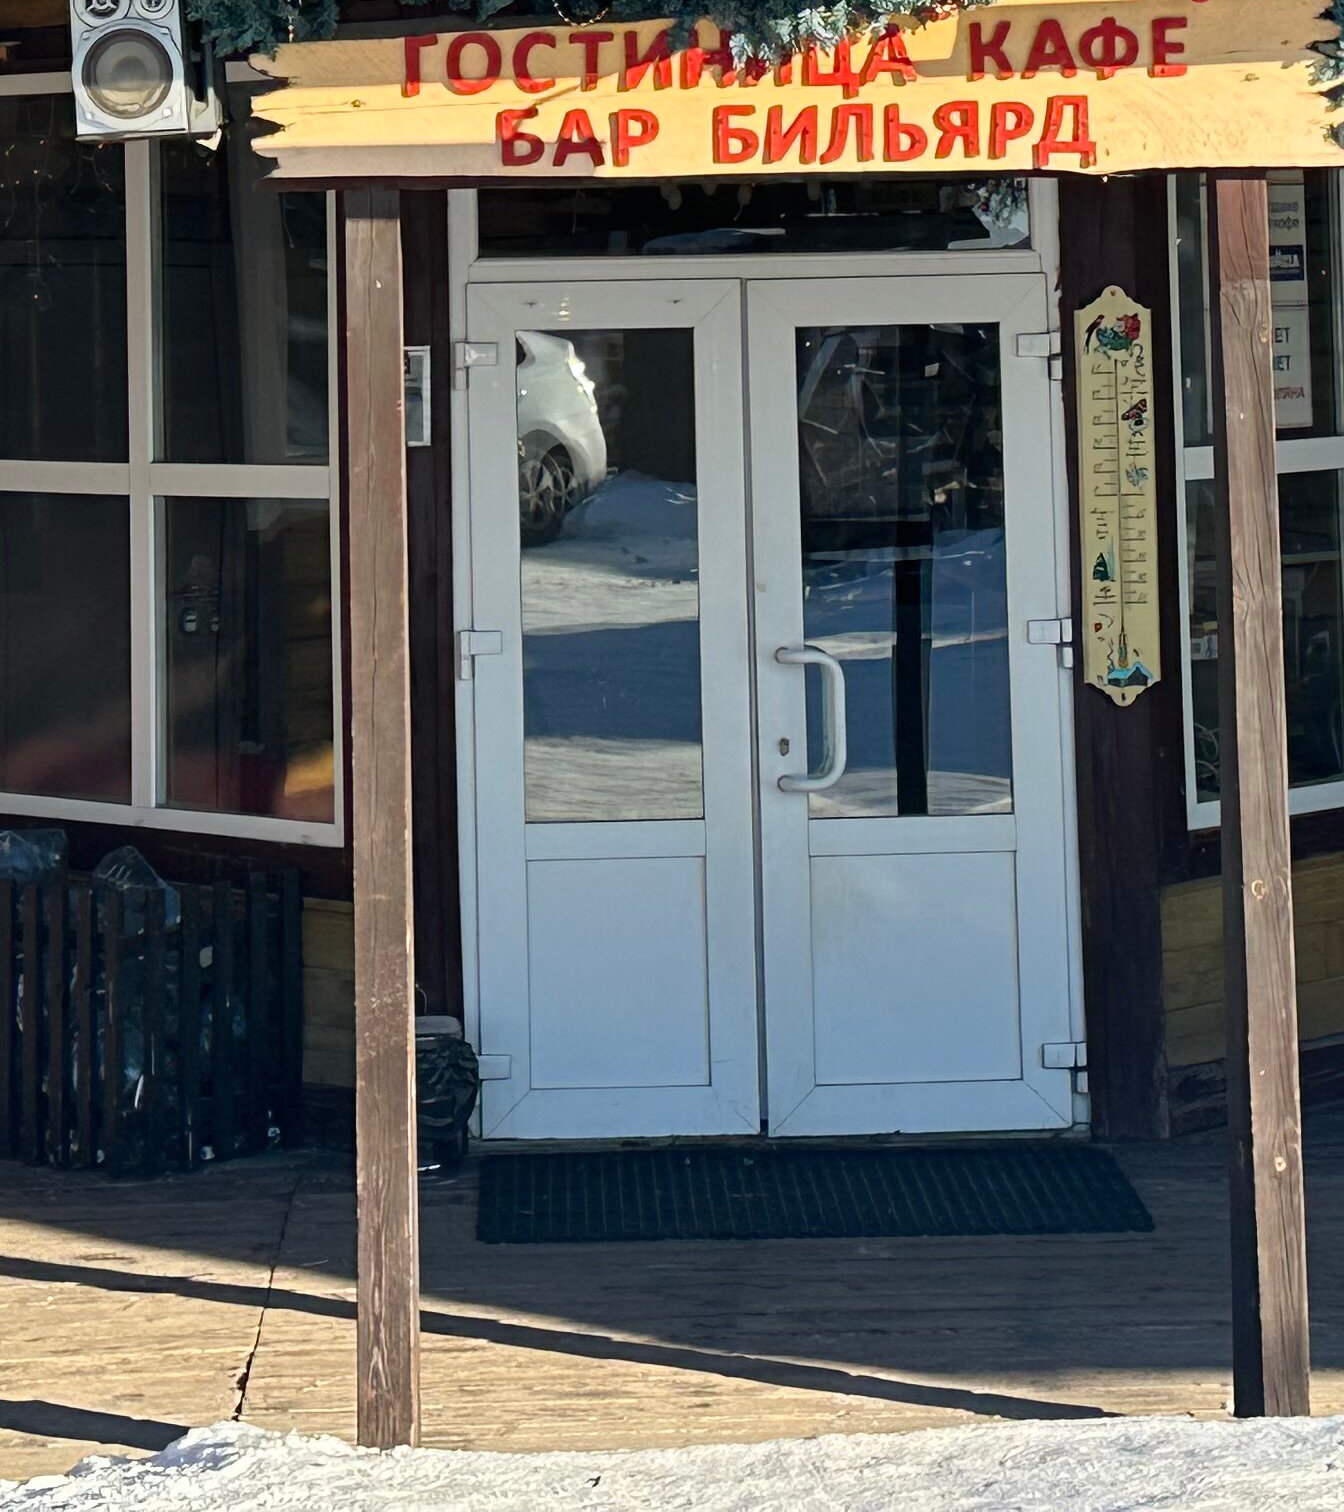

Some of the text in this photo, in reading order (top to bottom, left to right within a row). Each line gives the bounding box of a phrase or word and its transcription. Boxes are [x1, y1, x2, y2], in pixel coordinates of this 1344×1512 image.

[967, 16, 1189, 82] КАФЕ
[495, 95, 1098, 169] БАР БИЛЬЯРД
